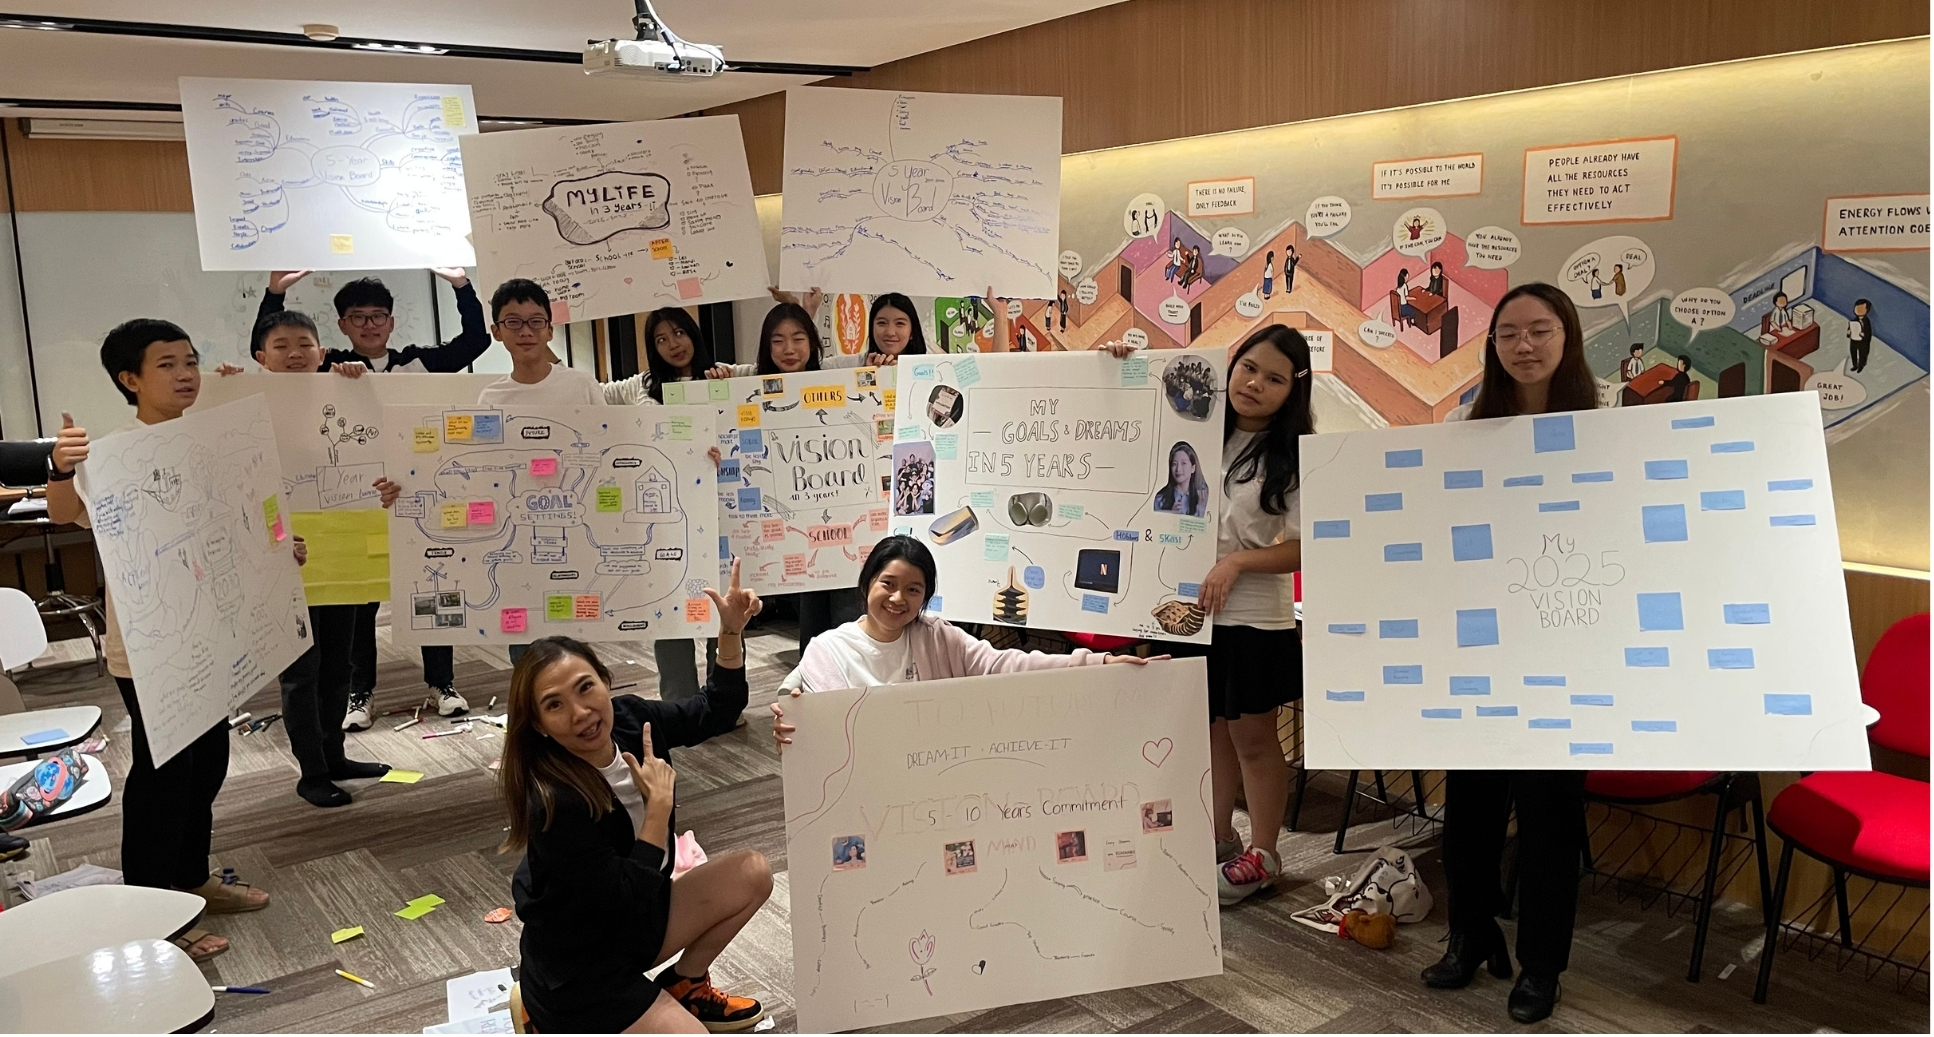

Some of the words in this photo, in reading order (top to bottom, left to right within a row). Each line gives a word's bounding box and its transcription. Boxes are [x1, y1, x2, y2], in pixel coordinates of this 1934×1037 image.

[1549, 156, 1579, 168] PEOPLE
[1582, 153, 1618, 164] ALREADY
[1621, 152, 1640, 161] HAVE
[1390, 169, 1403, 177] IT'S
[1405, 166, 1433, 175] POSSIBLE
[1457, 162, 1476, 170] WORLD
[1547, 174, 1562, 183] ALL
[1565, 172, 1578, 181] THE
[1582, 168, 1628, 180] RESOURCES
[1195, 189, 1211, 197] THERE
[1218, 187, 1226, 195] NO
[1395, 181, 1424, 189] POSSIBLE
[1547, 188, 1569, 197] THEY
[1572, 187, 1594, 196] NEED
[1599, 186, 1610, 194] TO
[1612, 183, 1631, 194] ACT
[1211, 200, 1237, 208] FEEDBACK
[1547, 200, 1613, 212] EFFECTIVELY
[1839, 208, 1883, 219] ENERGY
[1887, 207, 1921, 217] FLOWS
[1838, 225, 1905, 237] ATTENTION
[1625, 253, 1642, 261] DEAL
[1573, 259, 1591, 271] OPTION
[1743, 282, 1776, 304] DEADLINE
[1674, 306, 1700, 315] CHOOSE
[1702, 309, 1726, 317] OPTION
[1691, 317, 1697, 325] A
[1700, 317, 1705, 326] ?
[1816, 382, 1844, 391] GREAT
[803, 390, 842, 403] OTHERS
[1823, 394, 1844, 403] JOB!
[1030, 398, 1059, 416] MY
[1001, 419, 1060, 445] GOALS
[1075, 418, 1143, 443] DREAMS
[968, 451, 997, 473] IN
[1000, 453, 1014, 476] 5
[1024, 452, 1092, 480] YEARS
[336, 468, 364, 489] Year
[792, 462, 869, 492] Board
[526, 495, 573, 510] GOAL
[804, 492, 811, 500] 3
[520, 511, 577, 521] SETTINGS!
[809, 527, 850, 543] SCHOOL
[1144, 528, 1153, 543] &
[1542, 533, 1575, 555] My
[1506, 550, 1626, 594] 2025
[1529, 589, 1602, 610] VISION
[1539, 607, 1600, 629] BOARD
[989, 738, 1072, 755] ACHIEVE-IT
[928, 809, 937, 826] 5
[965, 806, 981, 822] 10
[997, 802, 1032, 821] Years
[1042, 795, 1128, 816] Commitment
